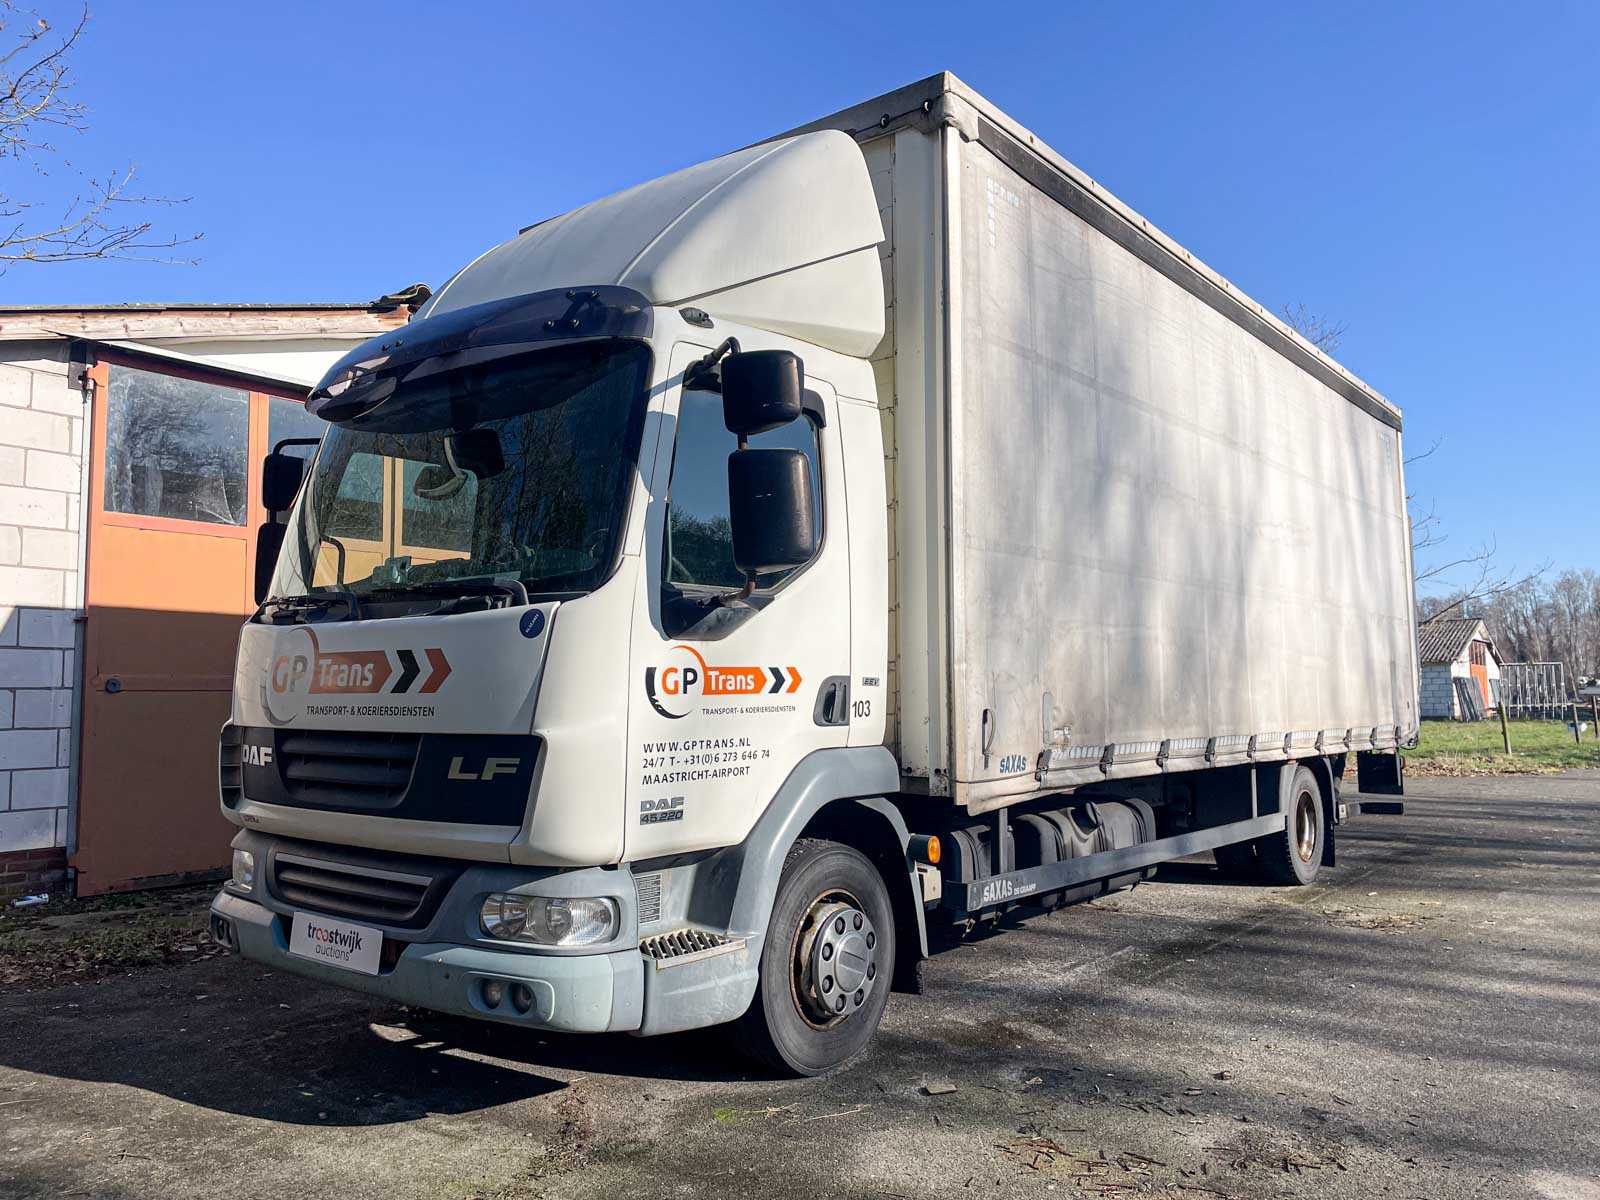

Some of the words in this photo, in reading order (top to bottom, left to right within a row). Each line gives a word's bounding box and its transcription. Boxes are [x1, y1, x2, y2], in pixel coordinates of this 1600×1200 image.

[272, 655, 308, 694] GP
[318, 658, 374, 688] Trans
[661, 667, 698, 694] GP
[708, 670, 755, 691] Trans
[357, 705, 435, 717] KOERIERSDIENSTEN
[851, 700, 871, 718] 103
[643, 737, 751, 753] WWW.GPTRANS.NL
[242, 744, 273, 767] DAF
[642, 757, 665, 769] 24/7
[722, 751, 738, 762] 273
[741, 750, 758, 760] 646
[761, 749, 770, 759] 74
[1000, 754, 1027, 774] SAXAS
[447, 756, 521, 781] LF
[642, 766, 751, 785] MAASTRICHT-AIRPORT
[640, 796, 685, 812] DAF
[983, 879, 1013, 902] SAXAS
[307, 922, 362, 954] troostwijk
[315, 944, 350, 961] auctions
